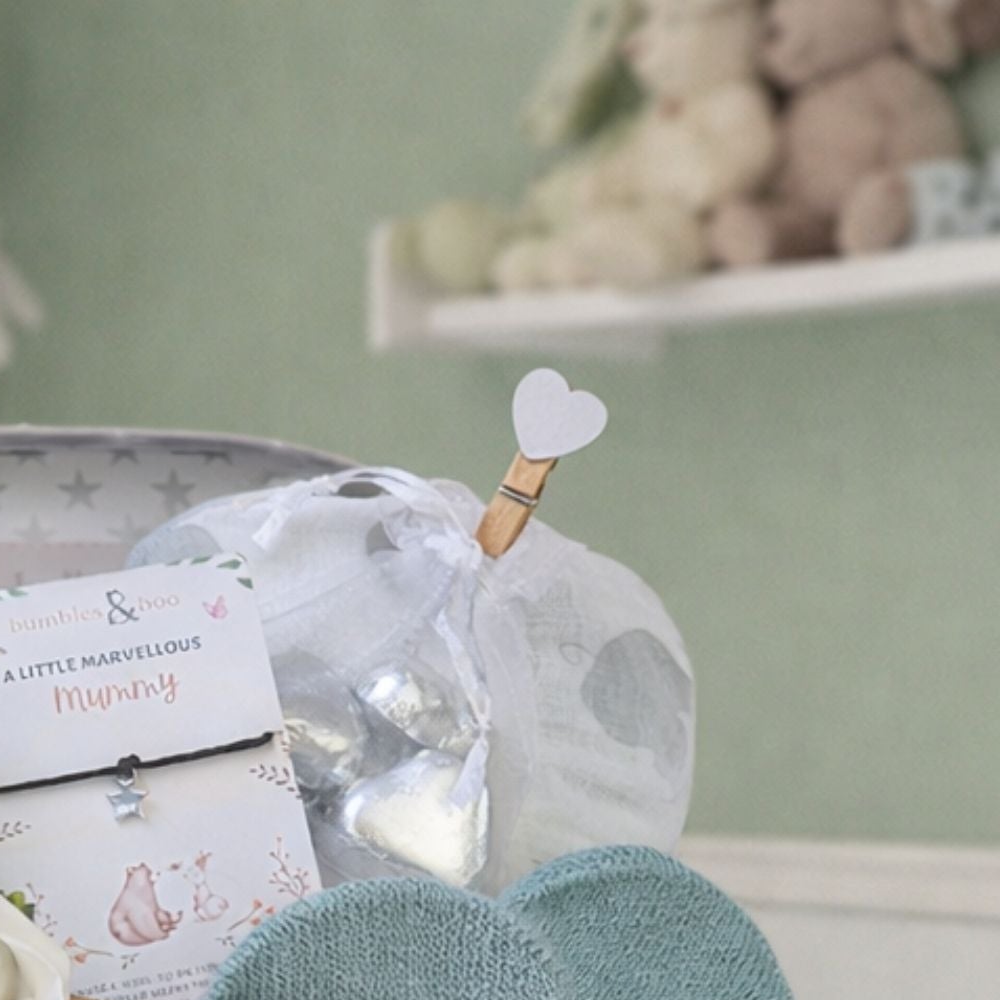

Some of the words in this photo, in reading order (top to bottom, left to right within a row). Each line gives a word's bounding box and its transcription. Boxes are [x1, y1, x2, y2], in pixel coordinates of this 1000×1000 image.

[9, 606, 103, 634] bumbles
[106, 589, 139, 625] &
[138, 593, 180, 613] boo
[3, 669, 15, 683] A
[19, 656, 78, 680] LITTLE
[81, 635, 202, 671] MARVELLOUS
